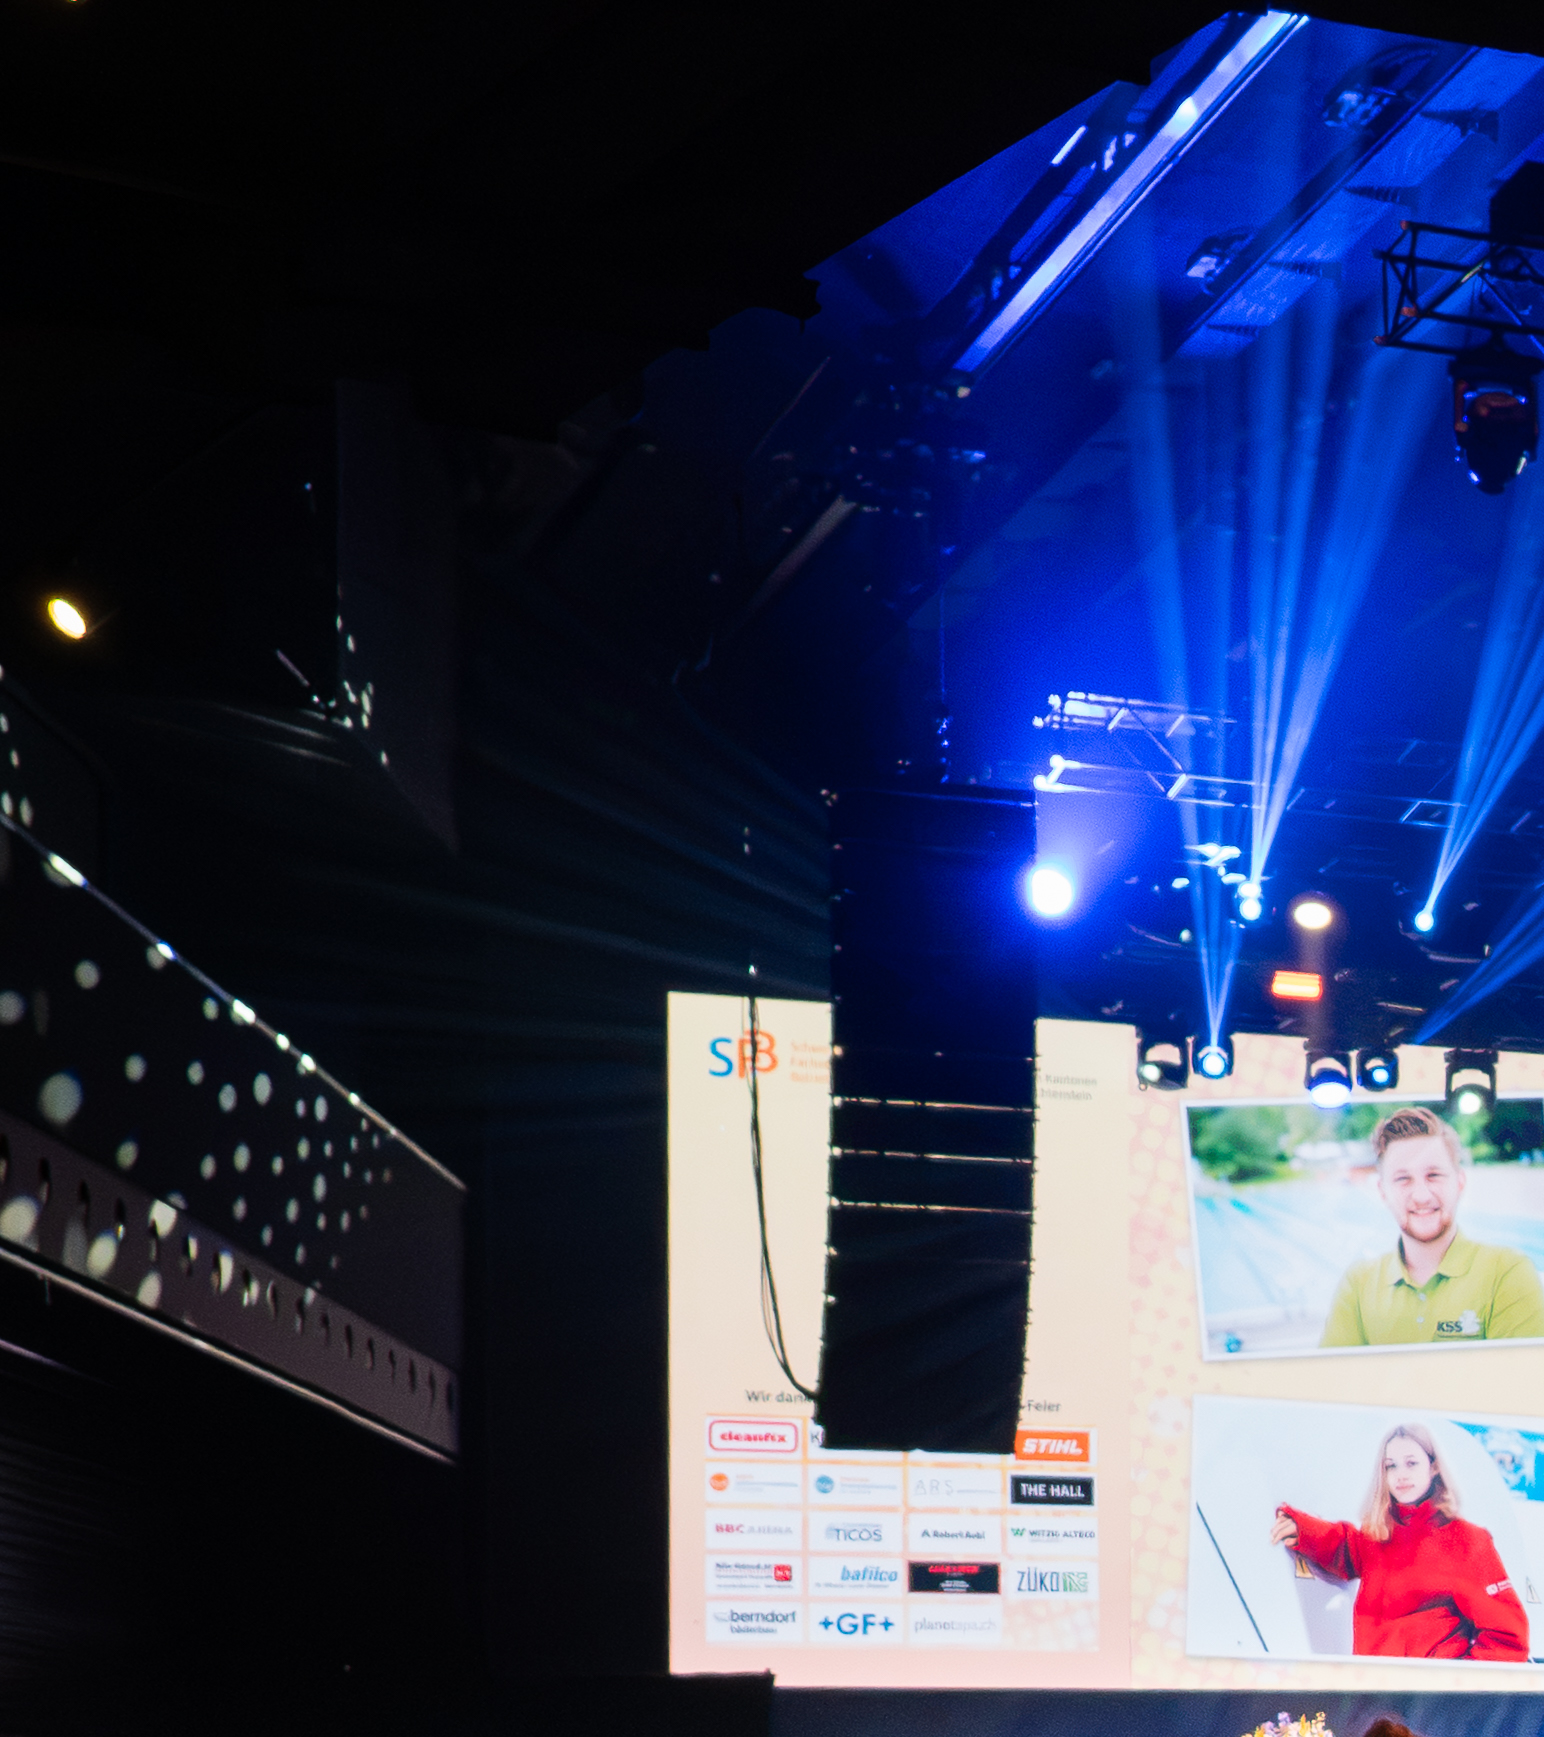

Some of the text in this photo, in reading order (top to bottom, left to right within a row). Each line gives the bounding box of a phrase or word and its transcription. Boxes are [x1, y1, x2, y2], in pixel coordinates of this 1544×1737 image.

[1436, 1320, 1463, 1333] KSS
[745, 1389, 770, 1402] Wir
[1022, 1437, 1083, 1455] STIHL
[1020, 1483, 1085, 1498] THE HALL
[730, 1609, 796, 1623] berndorf
